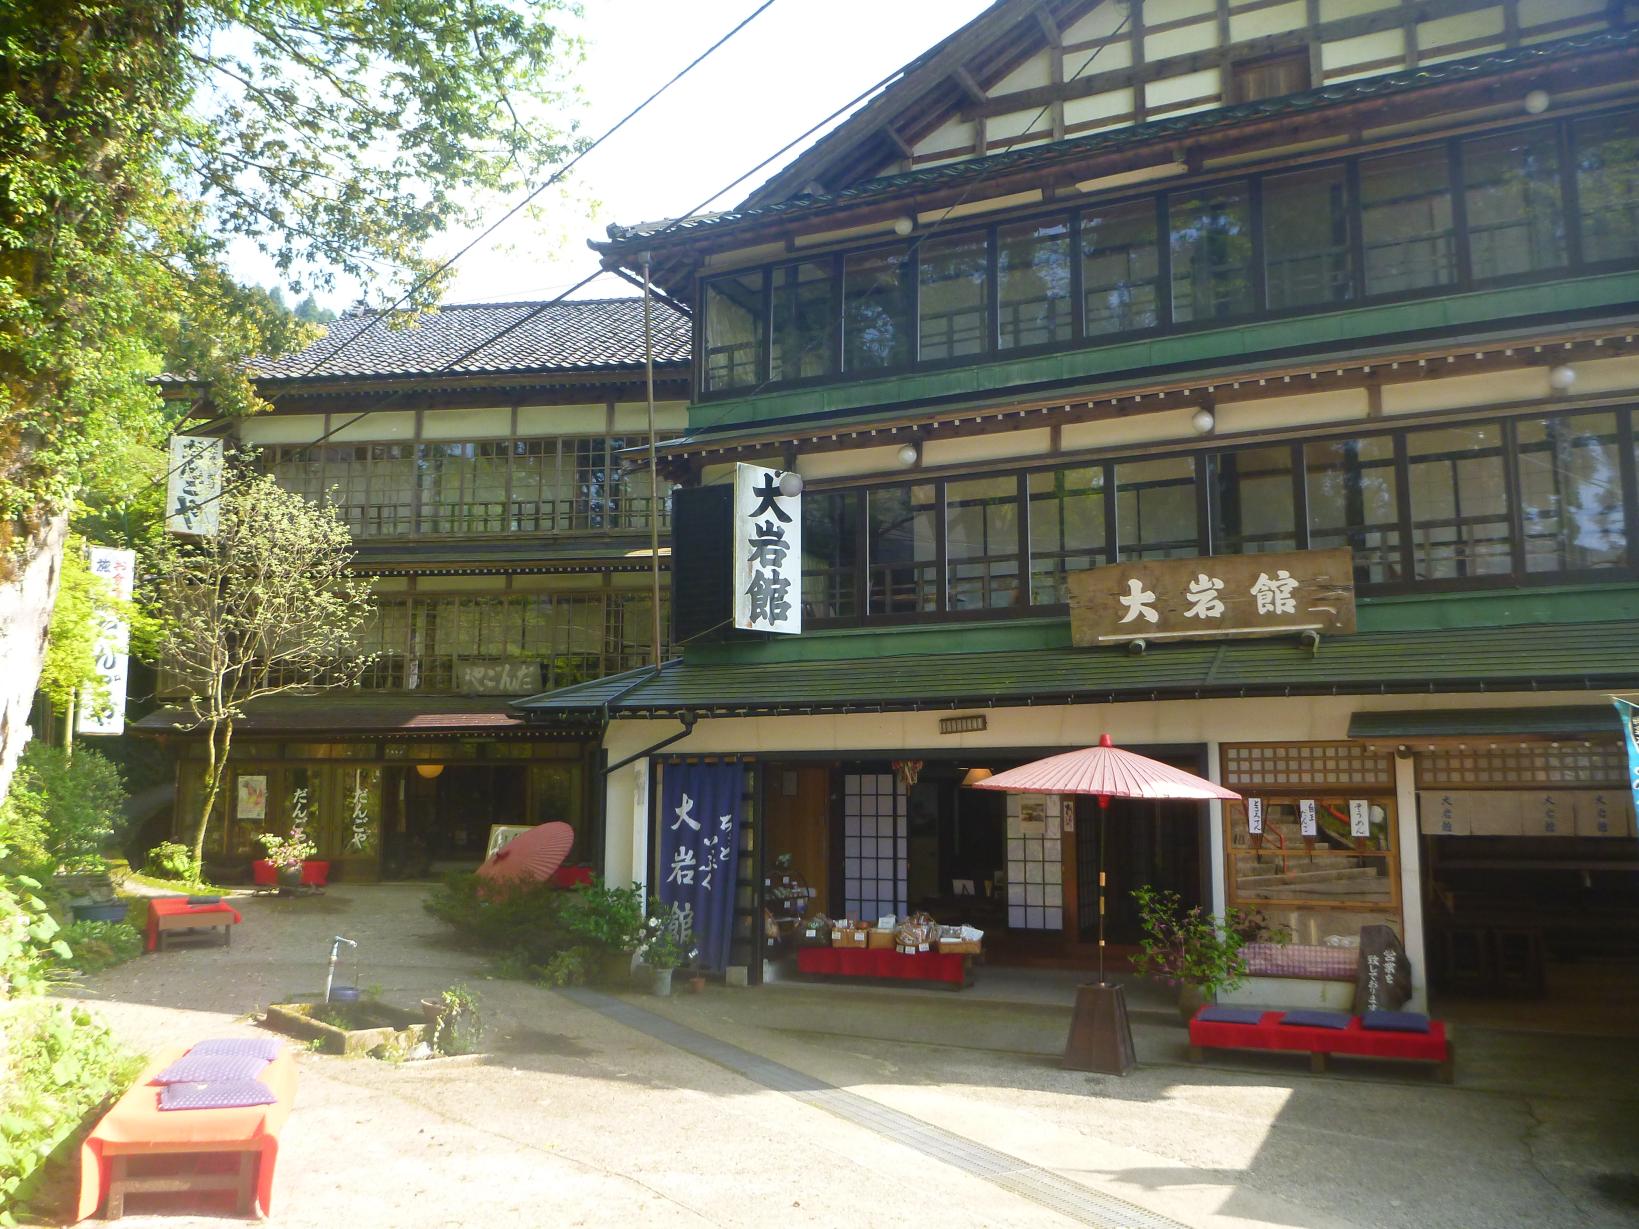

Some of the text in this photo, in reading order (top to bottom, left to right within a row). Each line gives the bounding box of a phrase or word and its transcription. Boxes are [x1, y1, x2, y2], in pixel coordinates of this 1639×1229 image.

[744, 472, 793, 627] 大岩館
[1117, 569, 1300, 624] 大岩館
[348, 787, 369, 849] だんごや
[666, 792, 702, 945] 大岩館
